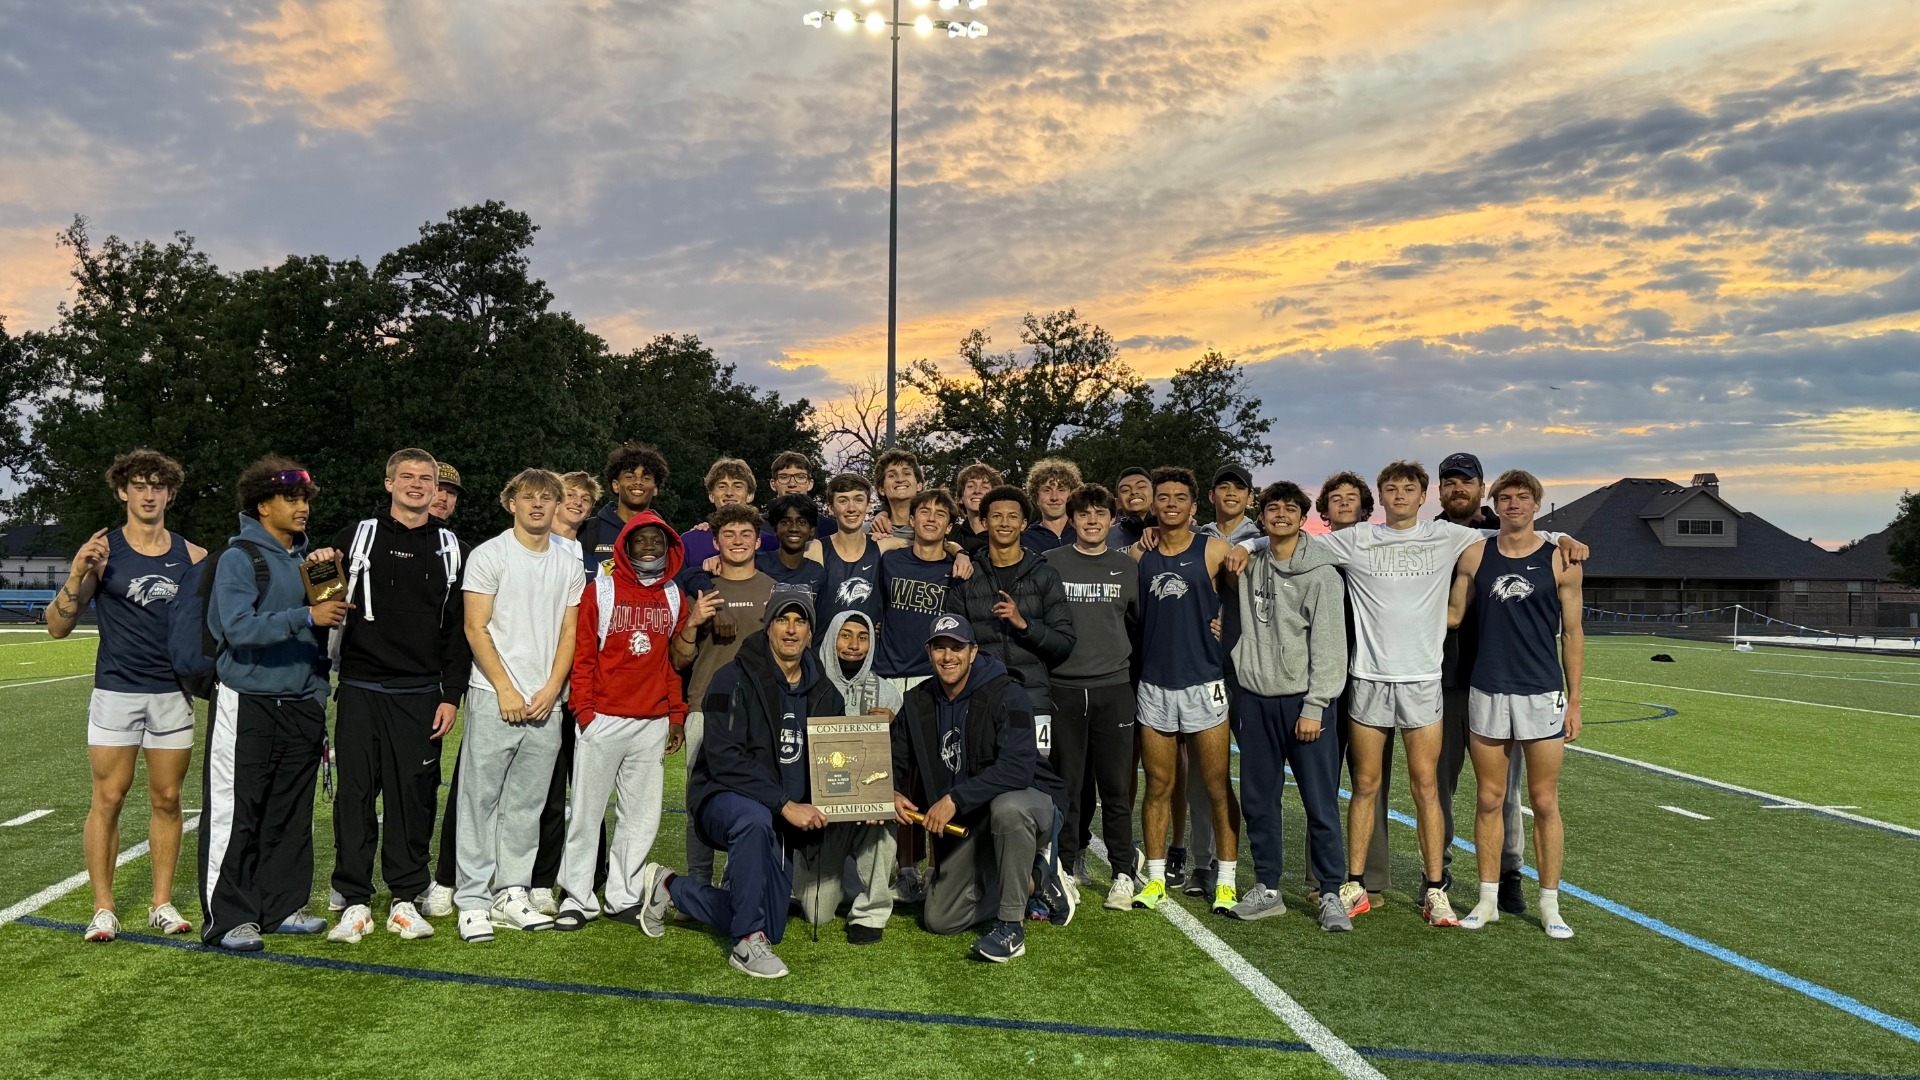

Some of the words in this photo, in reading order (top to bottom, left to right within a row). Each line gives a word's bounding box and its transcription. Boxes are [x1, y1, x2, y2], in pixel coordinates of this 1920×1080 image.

[1369, 544, 1435, 572] WEST
[891, 577, 950, 612] WEST
[1062, 582, 1101, 597] NTONVILLE
[1102, 583, 1122, 598] WEST
[1213, 684, 1224, 704] 4
[1556, 691, 1564, 712] 4
[816, 723, 882, 733] CONFERENCE
[1038, 724, 1049, 747] 4
[824, 803, 884, 814] CHAMPIONS
